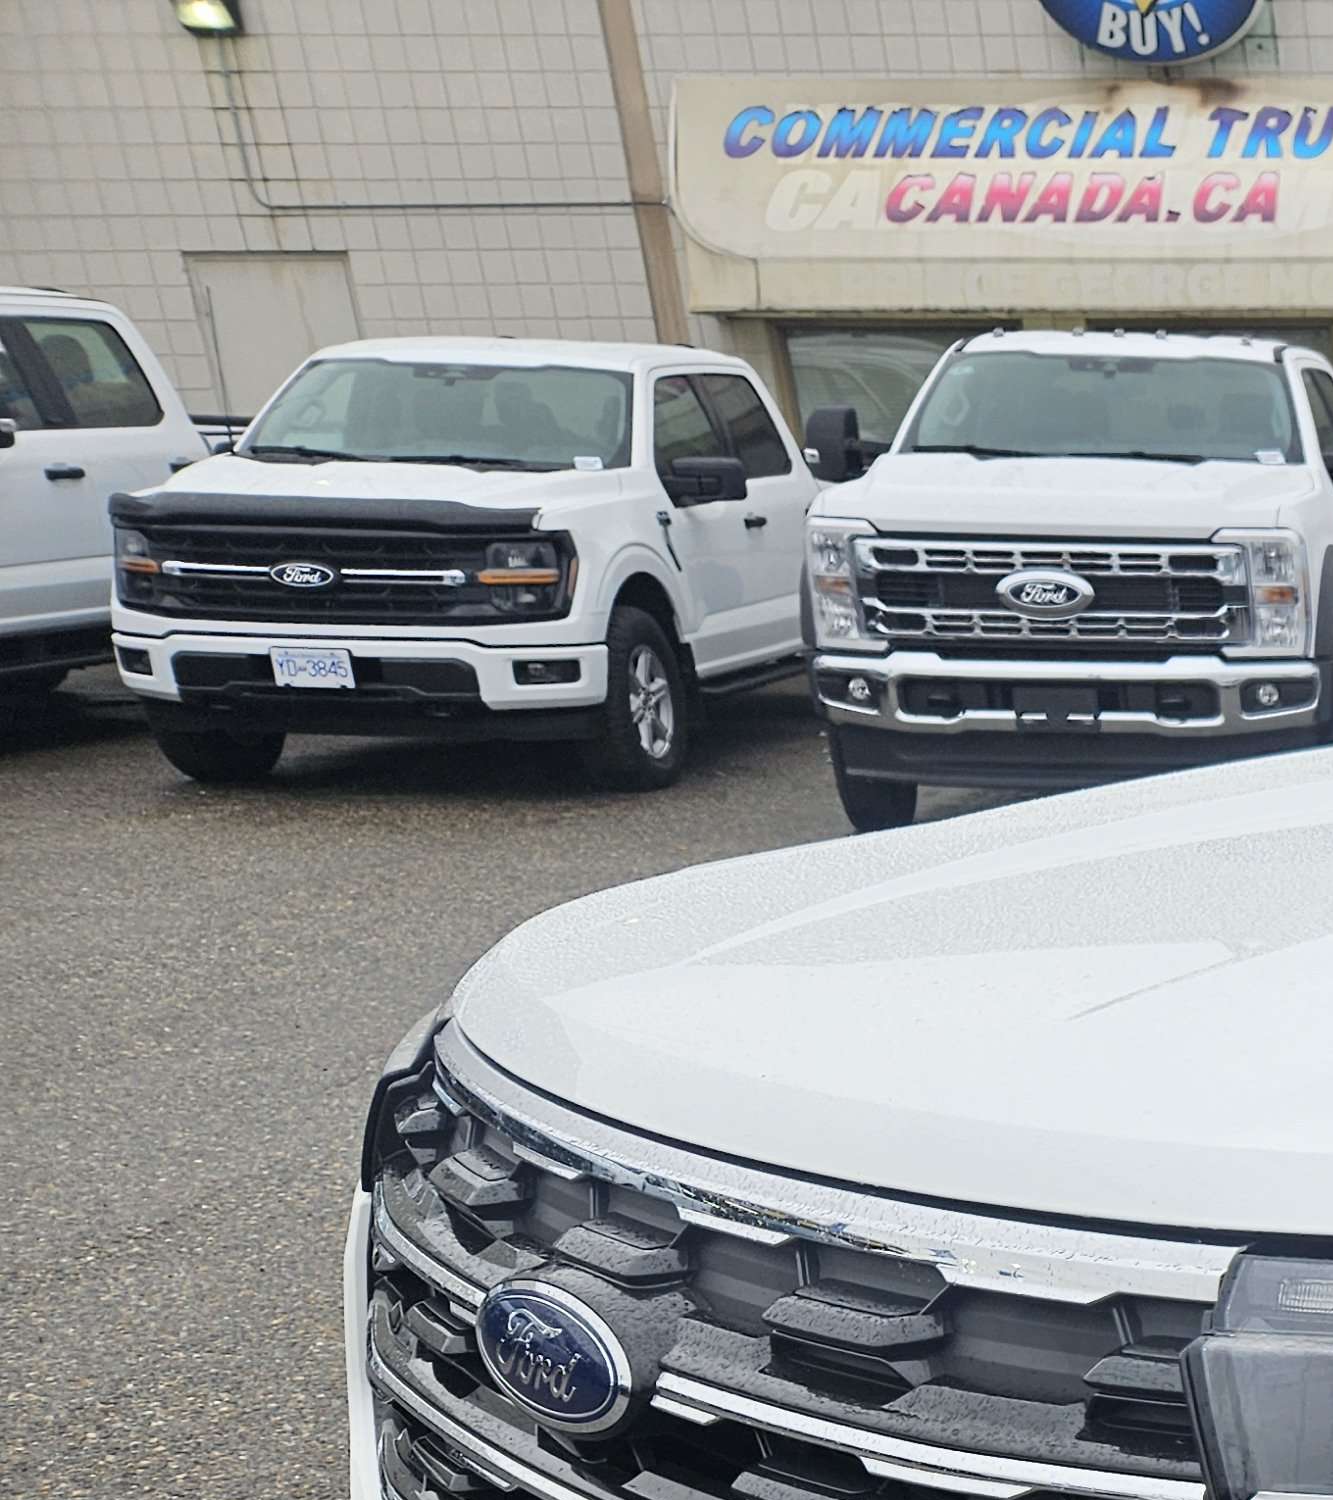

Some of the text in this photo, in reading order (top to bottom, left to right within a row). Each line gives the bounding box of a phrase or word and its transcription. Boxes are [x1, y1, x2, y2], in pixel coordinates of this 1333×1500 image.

[1097, 2, 1210, 55] BUY!
[723, 105, 1177, 160] COMMERCIAL
[884, 171, 1281, 224] CANADA.CA
[282, 567, 323, 583] Ford
[1021, 583, 1068, 604] Ford
[496, 1308, 582, 1402] Ford
